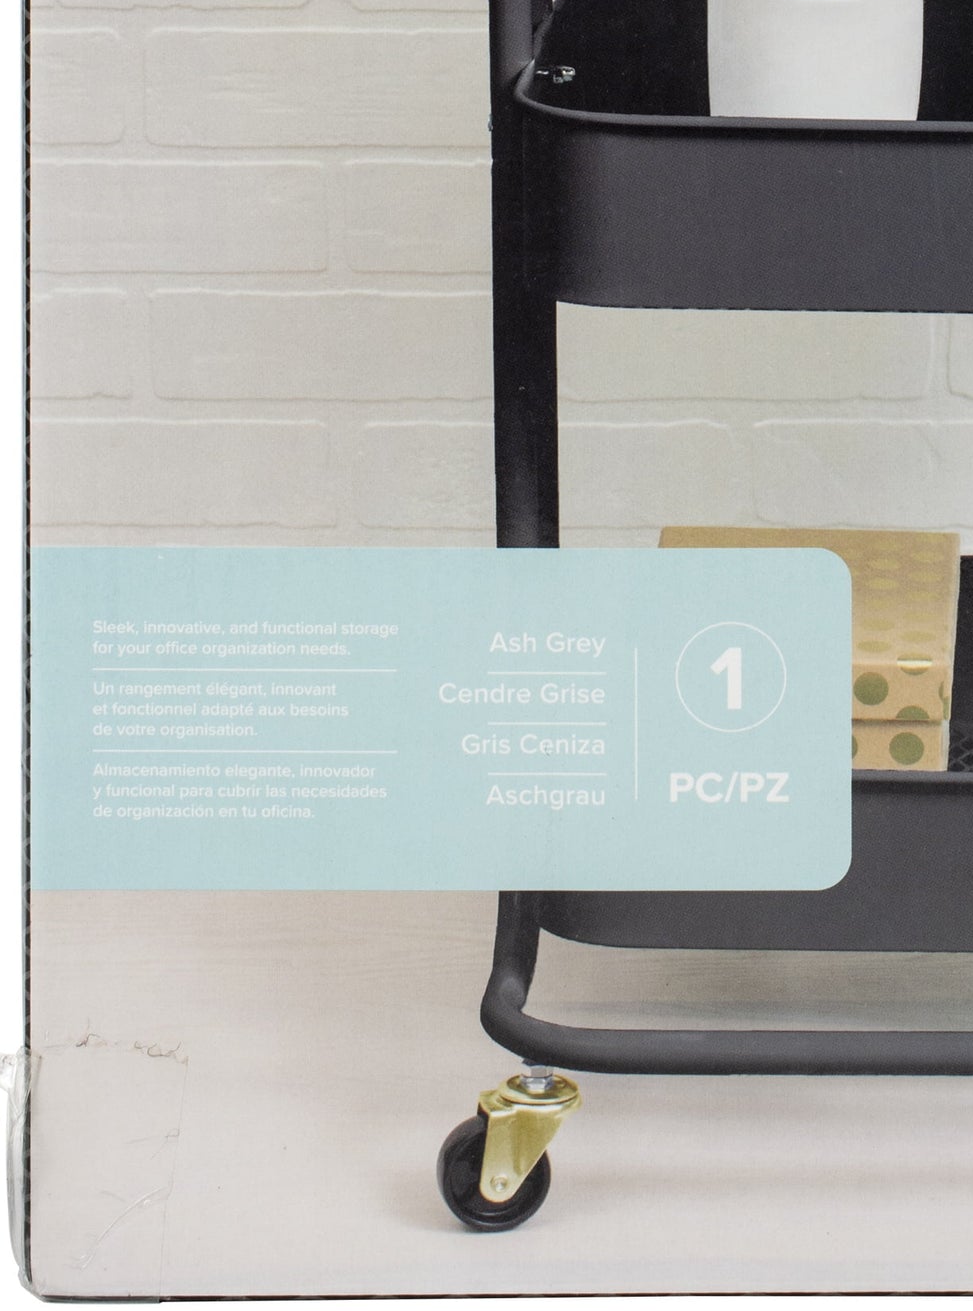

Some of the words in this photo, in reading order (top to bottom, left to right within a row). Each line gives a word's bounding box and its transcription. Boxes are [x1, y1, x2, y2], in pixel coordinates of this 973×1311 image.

[93, 620, 138, 634] Sleek,
[144, 620, 225, 634] innovative,
[229, 620, 259, 634] and
[263, 620, 337, 634] functional
[341, 620, 399, 638] storage
[93, 641, 114, 655] for
[117, 644, 151, 658] your
[156, 641, 198, 655] office
[202, 641, 296, 658] organization
[300, 641, 352, 655] needs.
[490, 632, 536, 653] Ash
[546, 632, 605, 657] Grey
[710, 647, 742, 710] 1
[93, 681, 114, 695] Un
[119, 681, 201, 699] rangement
[206, 681, 267, 699] élégant,
[271, 681, 337, 695] innovant
[439, 683, 531, 704] Cendre
[540, 683, 605, 704] Grise
[93, 702, 107, 716] et
[112, 702, 197, 716] fonctionnel
[201, 702, 254, 719] adapté
[258, 705, 286, 716] aux
[290, 702, 349, 716] besoins
[93, 722, 112, 736] de
[116, 722, 156, 736] votre
[160, 722, 259, 740] organisation.
[461, 734, 511, 755] Gris
[520, 734, 605, 755] Ceniza
[93, 763, 221, 777] Almacenamiento
[225, 763, 296, 780] elegante,
[300, 763, 376, 777] innovador
[93, 787, 101, 801] y
[106, 784, 176, 798] funcional
[179, 787, 213, 801] para
[217, 784, 262, 798] cubrir
[265, 784, 288, 798] las
[291, 784, 388, 798] necesidades
[670, 772, 790, 804] PC/PZ
[486, 785, 605, 810] Aschgrau
[93, 804, 112, 818] de
[117, 804, 215, 822] organización
[218, 807, 238, 818] en
[241, 804, 258, 818] tu
[261, 804, 315, 818] oficina.
